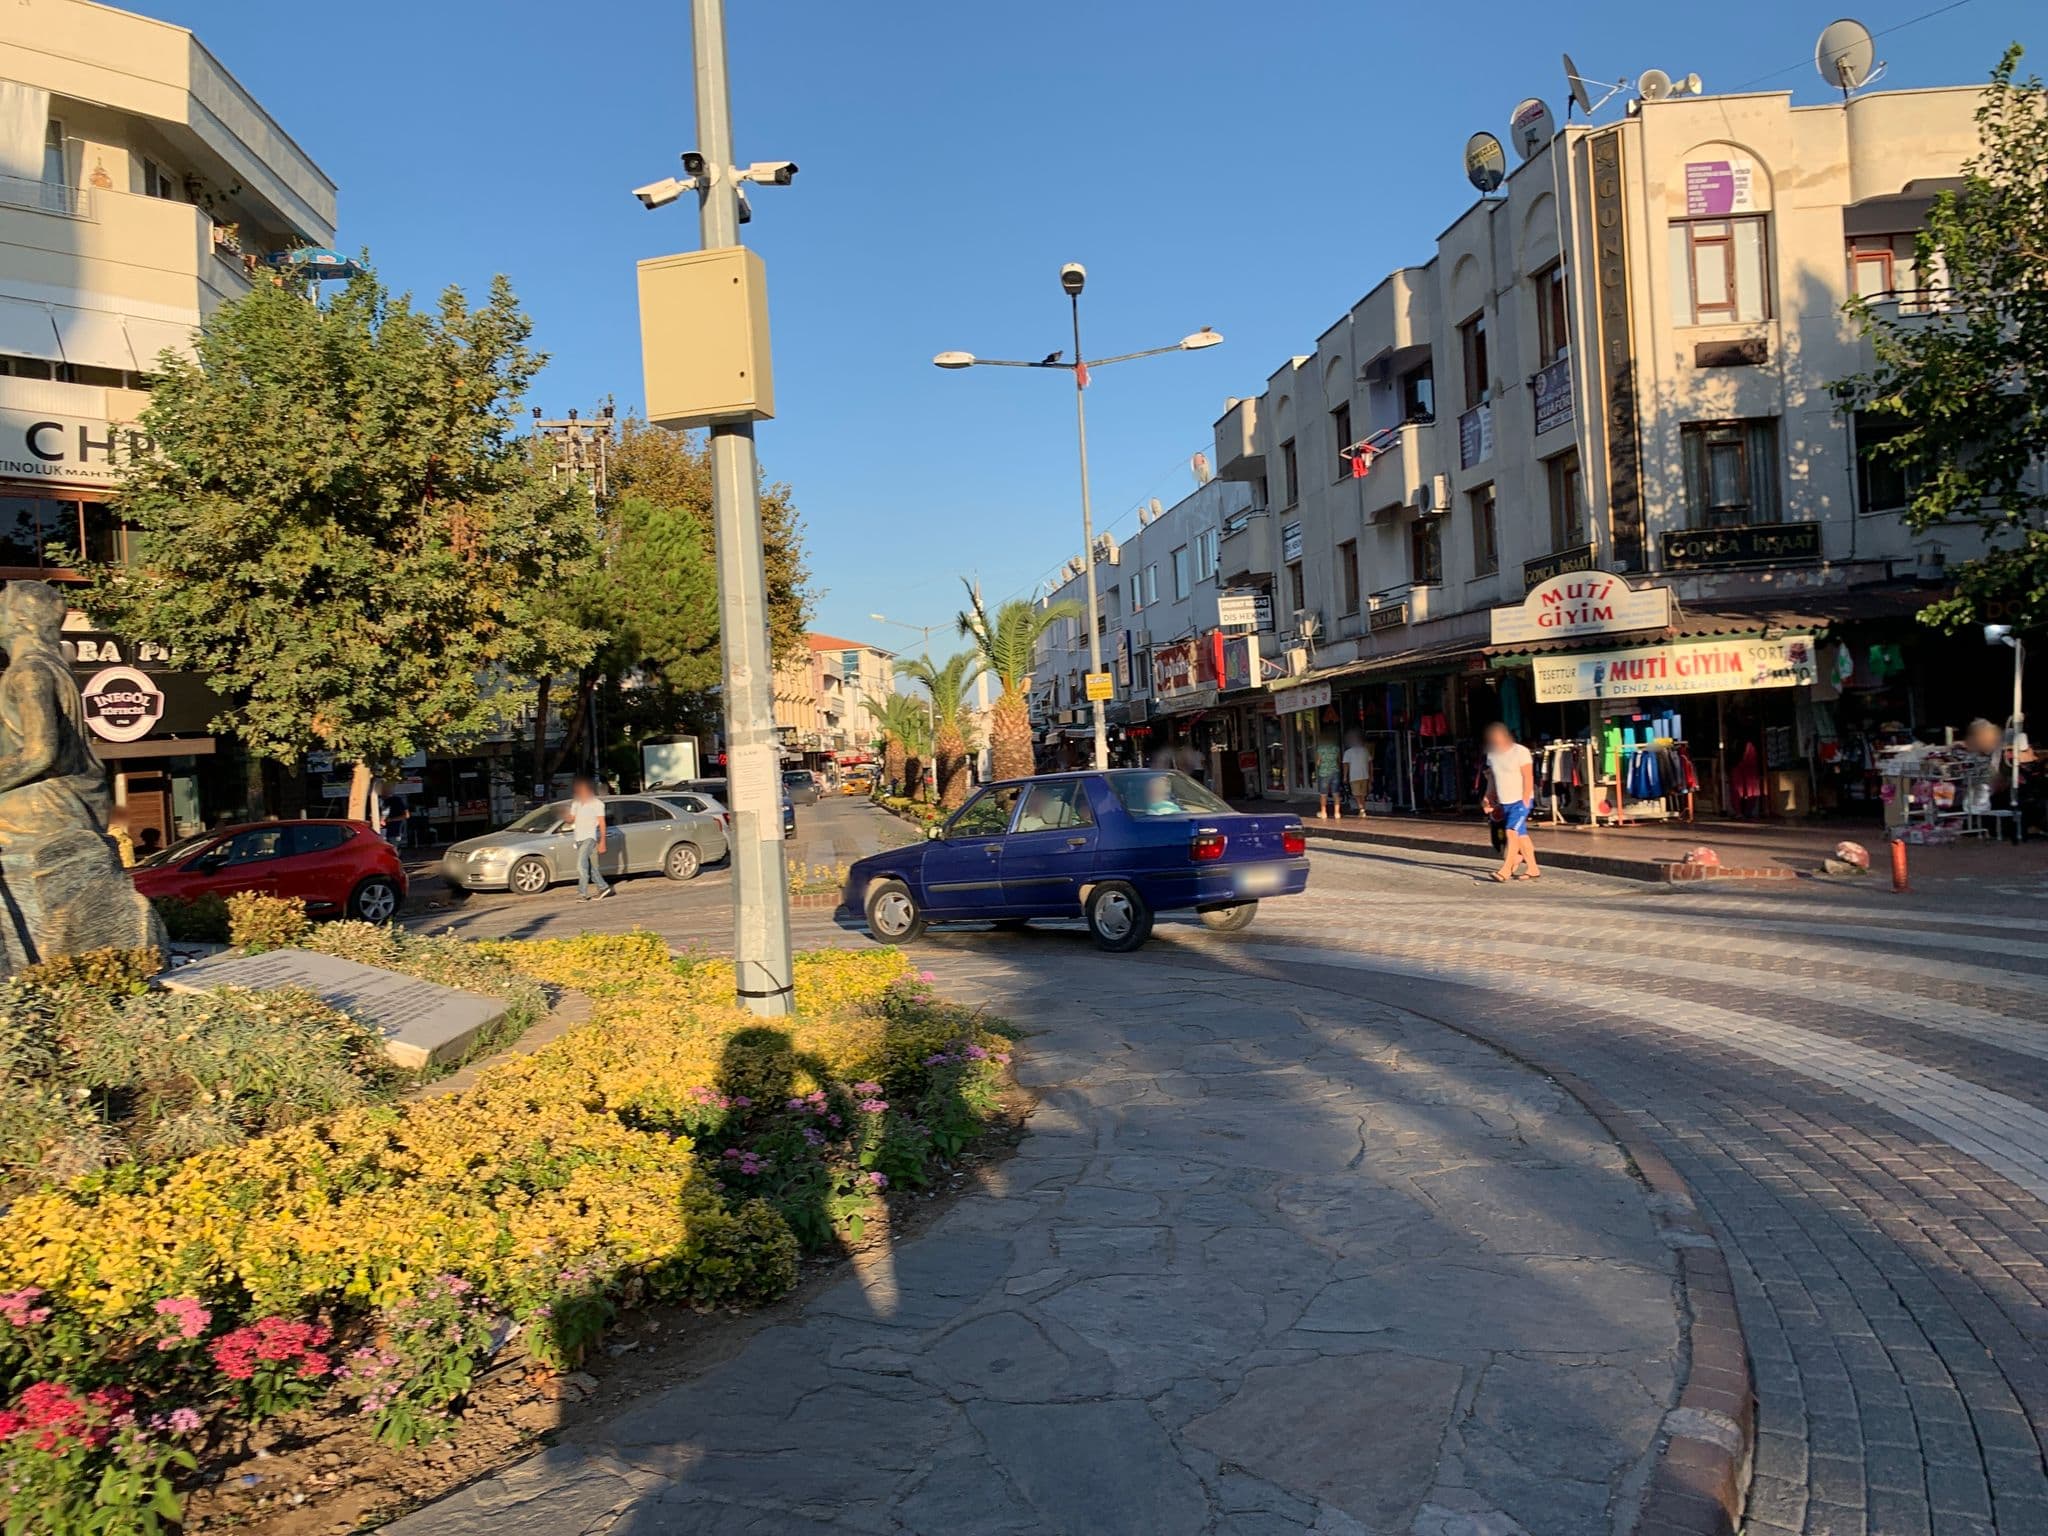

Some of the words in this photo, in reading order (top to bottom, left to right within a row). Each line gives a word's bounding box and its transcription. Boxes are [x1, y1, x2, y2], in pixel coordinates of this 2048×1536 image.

[1540, 579, 1614, 607] MUTİ
[1538, 602, 1614, 628] GİYİM
[1609, 651, 1667, 682] MUTİ
[1675, 647, 1743, 676] GİYİM
